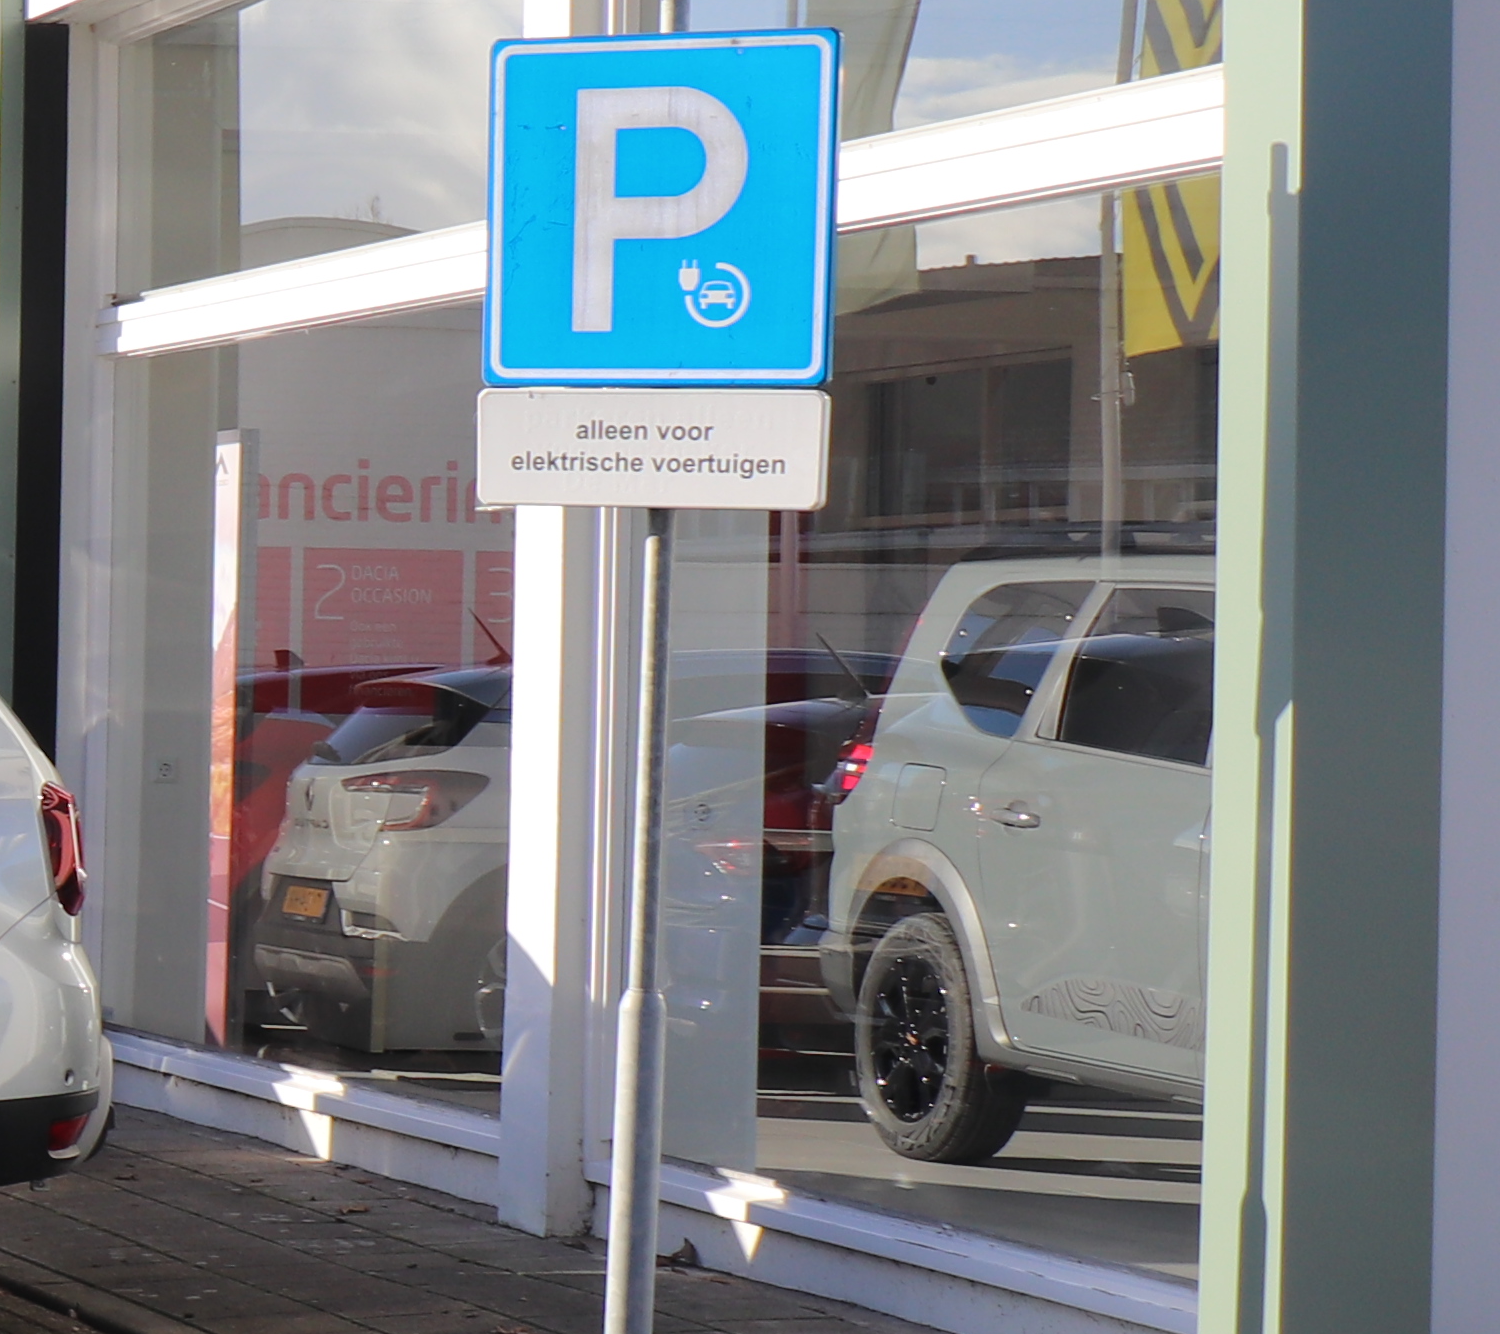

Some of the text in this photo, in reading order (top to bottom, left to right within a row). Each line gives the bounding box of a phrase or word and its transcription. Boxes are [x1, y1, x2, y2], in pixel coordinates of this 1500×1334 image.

[571, 85, 749, 333] P
[575, 419, 715, 441] alleen voor
[510, 450, 786, 479] elektrische voertuigen
[351, 565, 400, 582] DACIA
[314, 564, 346, 621] 2
[351, 587, 433, 605] OCCASION
